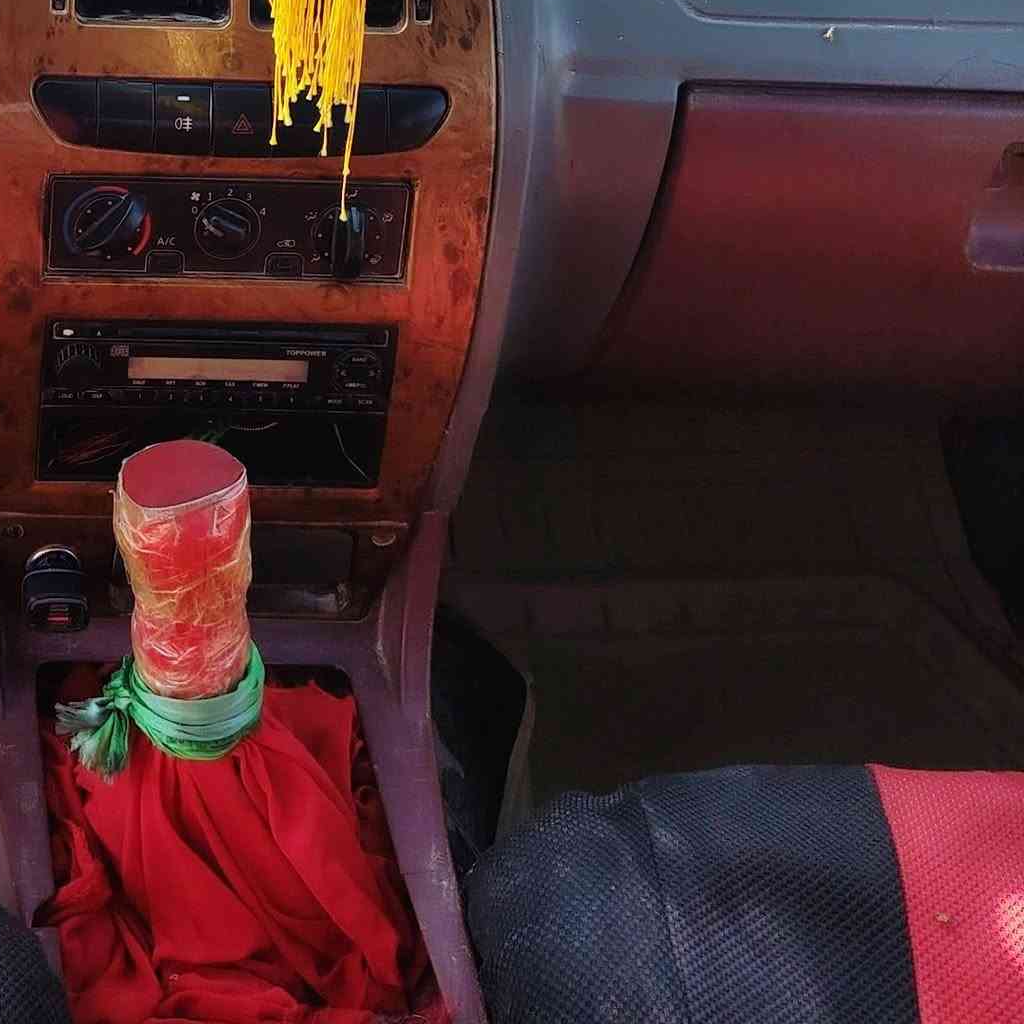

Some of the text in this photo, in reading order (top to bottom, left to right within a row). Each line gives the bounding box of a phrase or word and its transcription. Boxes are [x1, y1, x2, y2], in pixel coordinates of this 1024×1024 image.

[227, 188, 233, 197] 2
[260, 207, 267, 216] 4
[157, 236, 176, 247] A/C
